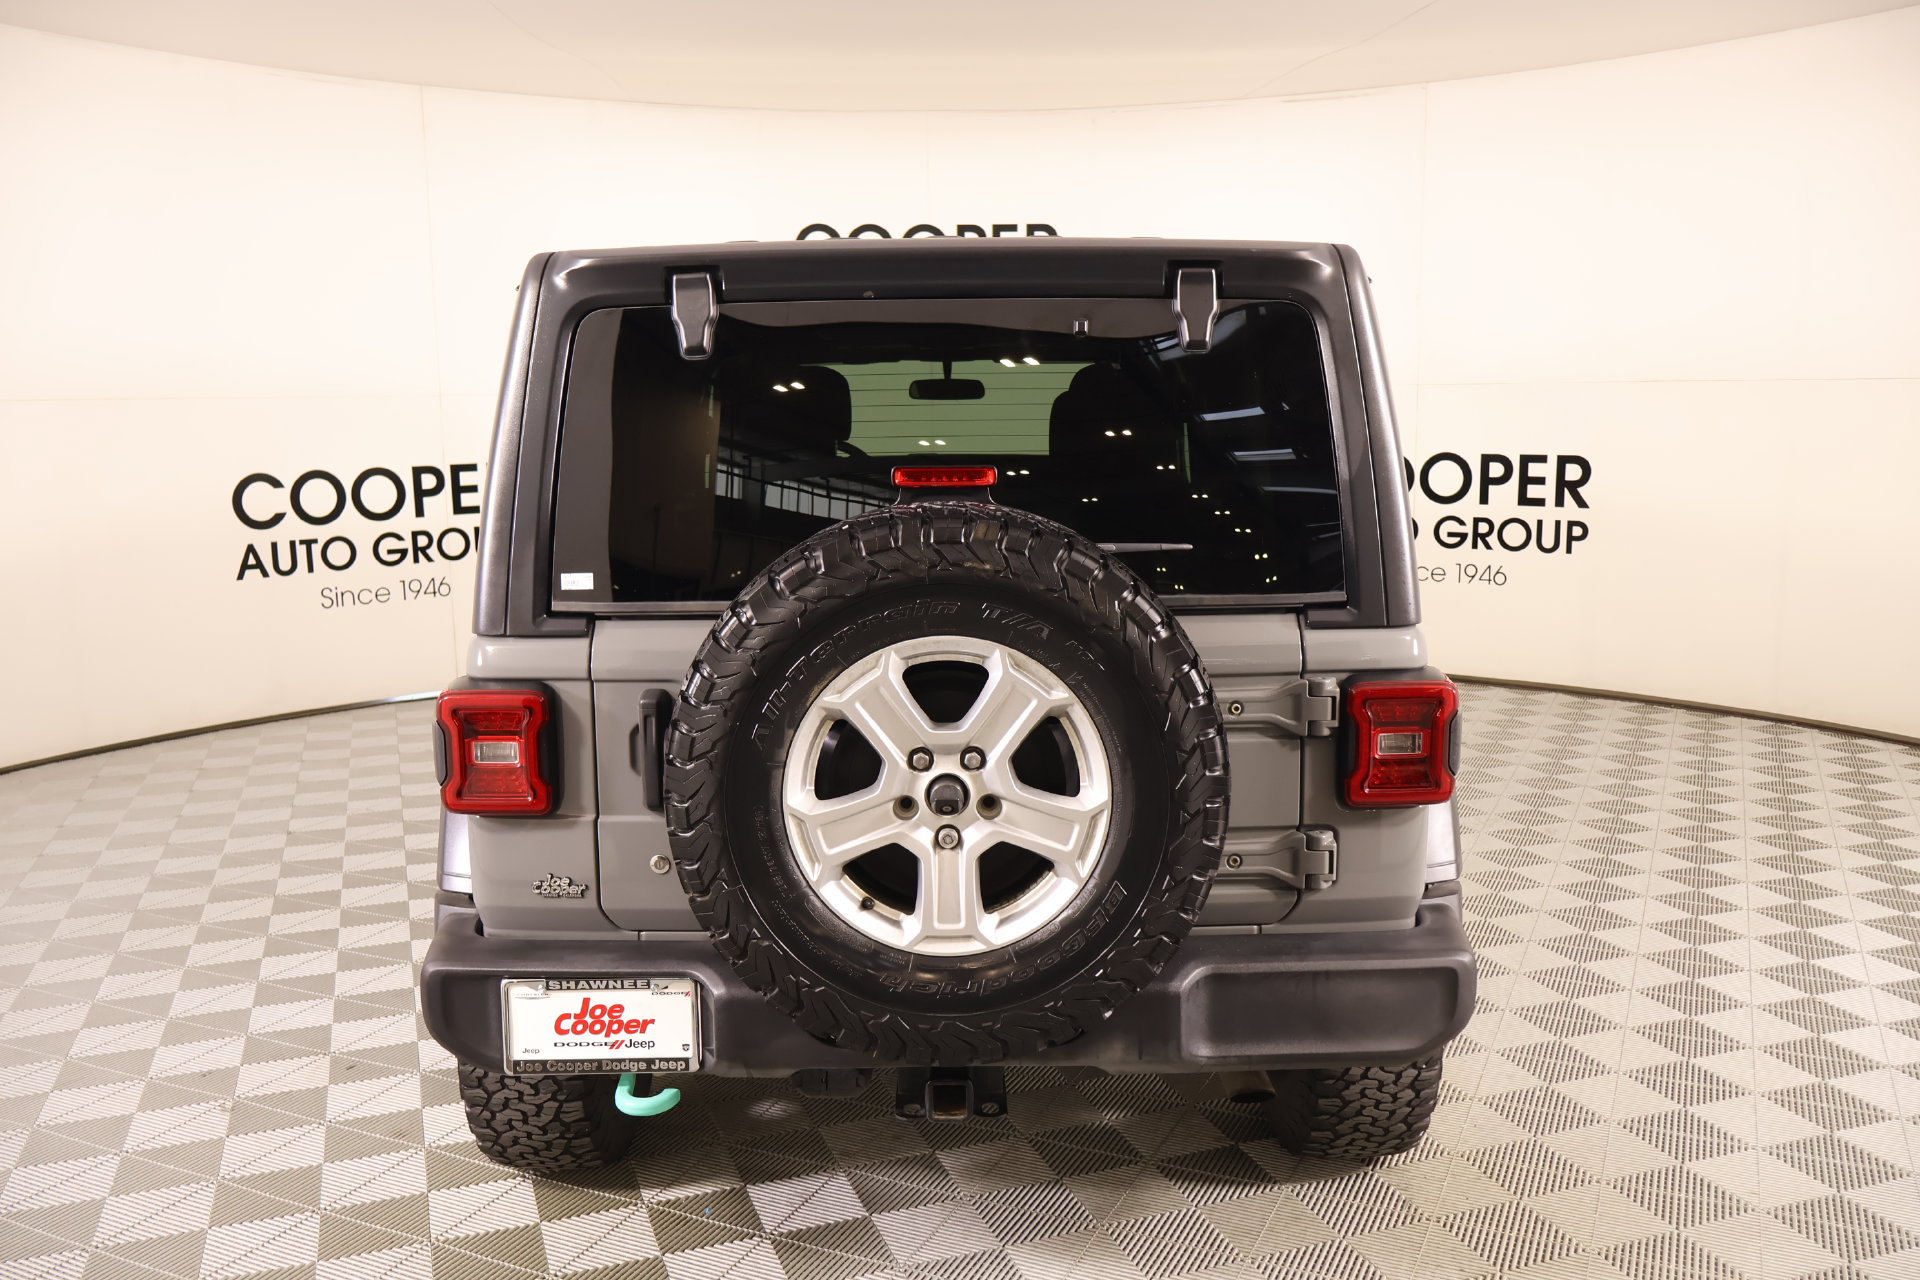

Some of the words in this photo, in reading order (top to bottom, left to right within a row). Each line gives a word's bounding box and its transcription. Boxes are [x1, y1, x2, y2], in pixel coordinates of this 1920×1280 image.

[1403, 452, 1592, 509] OPER
[231, 463, 481, 530] COOPE
[1433, 515, 1589, 555] GROUP
[236, 536, 357, 581] AUTO
[372, 526, 480, 567] GRO
[1455, 563, 1508, 586] 1946
[320, 586, 391, 609] Since
[400, 576, 451, 601] 1946
[531, 881, 589, 896] Cooper
[548, 979, 649, 991] SHAWNEE
[573, 997, 625, 1020] Joe
[554, 1013, 655, 1037] Cooper
[624, 1038, 656, 1049] Jeep
[516, 1060, 543, 1072] Joe
[546, 1060, 599, 1073] Cooper
[602, 1059, 647, 1071] Dodge
[650, 1059, 686, 1071] Jeep
